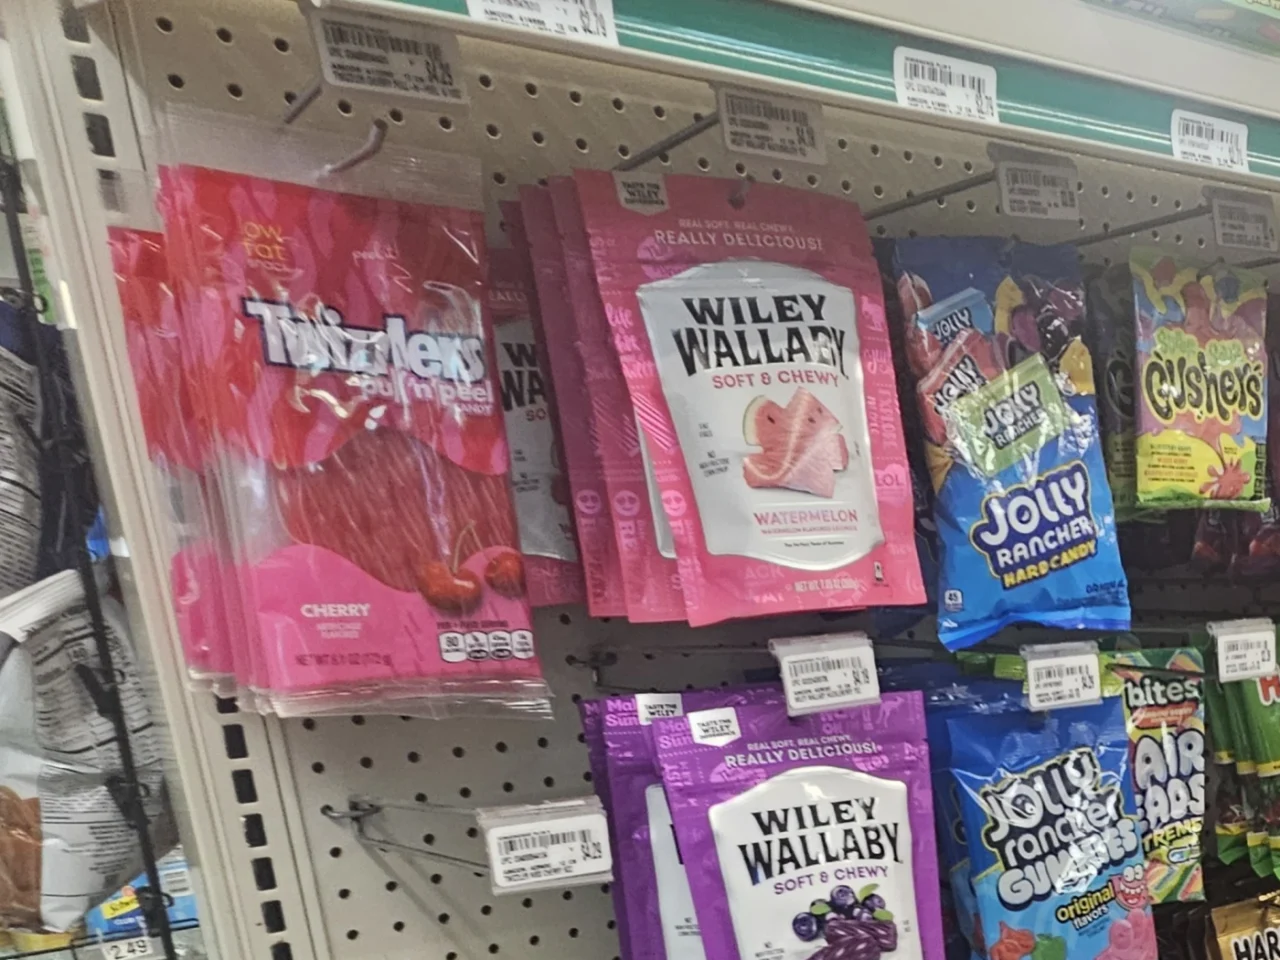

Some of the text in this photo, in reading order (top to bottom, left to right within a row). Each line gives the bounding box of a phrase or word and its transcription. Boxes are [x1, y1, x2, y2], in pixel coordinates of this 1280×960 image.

[653, 230, 823, 251] REALLY DELICIOUS!
[680, 293, 827, 327] WILEY
[933, 306, 972, 341] JOLLY
[671, 325, 850, 381] WALLABY
[439, 379, 493, 404] peel
[711, 368, 840, 390] SOFT & CHEWY
[1144, 350, 1264, 422] Gushers
[753, 508, 858, 527] WATERMELON
[979, 470, 1089, 547] JOLLY
[995, 515, 1095, 568] RANCHER
[1002, 539, 1098, 588] HARD CANDY
[300, 603, 371, 619] CHERRY
[1127, 677, 1203, 707] bites
[702, 724, 732, 736] WILEY
[747, 741, 769, 751] REAL
[797, 736, 819, 747] REAL
[724, 741, 878, 769] REALLY DELICIOUS!
[1134, 727, 1205, 790] AIR
[988, 748, 1099, 842] JOLLY
[750, 796, 880, 836] WILEY
[737, 822, 904, 887] WALLABY
[773, 864, 890, 896] SOFT & CHEWY
[1055, 883, 1116, 922] original
[1072, 903, 1109, 931] flavors
